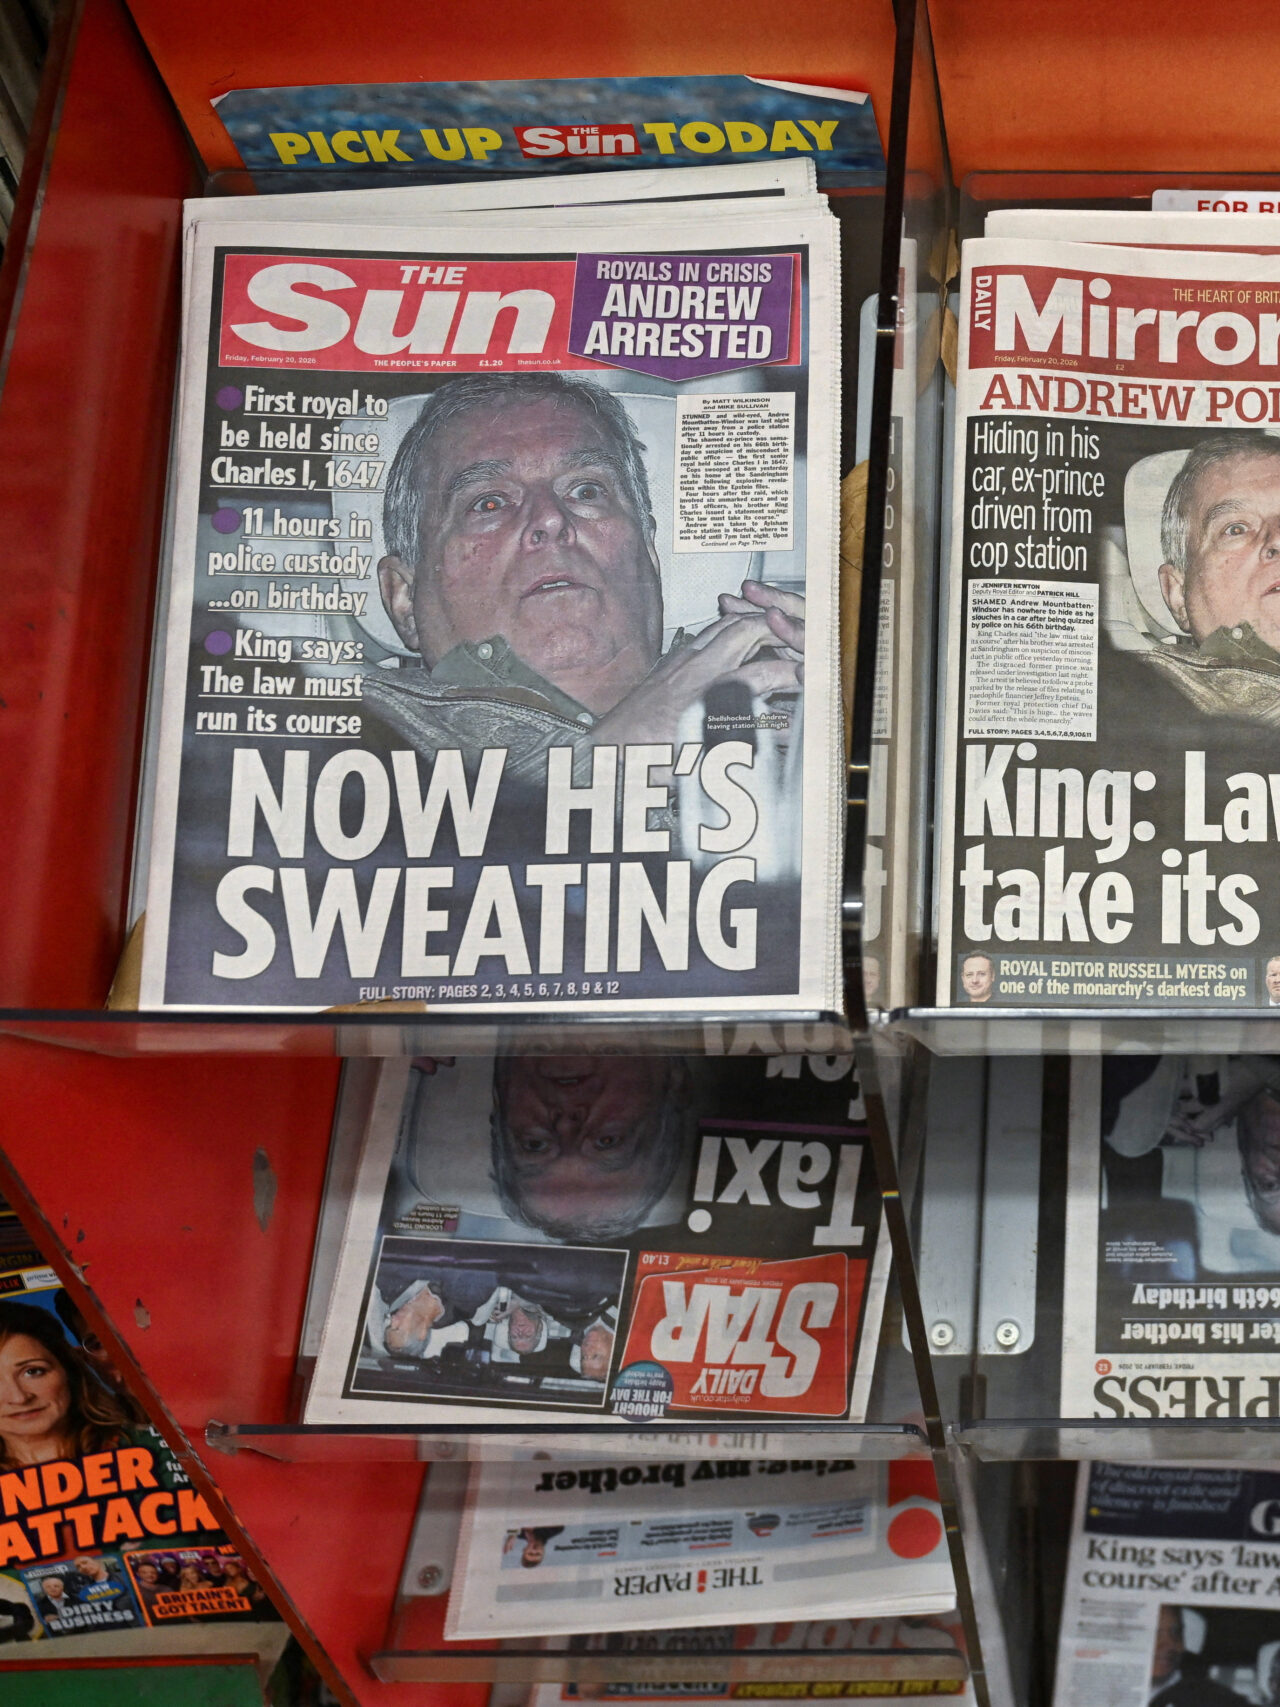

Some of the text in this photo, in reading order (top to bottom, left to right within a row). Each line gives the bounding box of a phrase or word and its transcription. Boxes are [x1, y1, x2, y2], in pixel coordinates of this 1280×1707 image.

[269, 120, 840, 164] PICK UP THE Sun TODAY
[398, 265, 468, 285] THE
[596, 261, 772, 284] ROYALS IN CRISIS
[230, 264, 557, 355] Sun
[600, 284, 762, 321] ANDREW
[974, 274, 992, 331] DAILY
[1173, 288, 1194, 302] THE
[1197, 289, 1236, 303] HEART
[1238, 290, 1253, 303] OF
[584, 321, 772, 359] ARRESTED
[374, 359, 457, 368] THE PEOPLE'S PAPER
[479, 359, 503, 367] £1.20
[243, 386, 388, 421] First royal to
[980, 373, 1194, 422] ANDREW
[221, 422, 379, 453] be held since
[974, 423, 1100, 461] Hiding in his
[210, 457, 385, 491] Charles I, 1647
[972, 464, 1105, 502] car, ex-prince
[971, 499, 1092, 535] driven from
[970, 537, 1087, 576] cop station
[234, 631, 364, 665] King says:
[200, 665, 364, 697] The law must
[196, 705, 362, 735] run its course
[227, 741, 759, 860] NOW HE'S
[963, 743, 1156, 863] King:
[959, 845, 1134, 946] take
[1161, 847, 1260, 946] its
[212, 857, 757, 979] SWEATING
[1000, 961, 1247, 980] ROYAL EDITOR RUSSELL MYERS on
[688, 1136, 865, 1245] Taxi
[642, 1254, 670, 1265] £1.40
[1132, 1283, 1227, 1310] birthday
[651, 1280, 839, 1397] STAR
[1121, 1322, 1205, 1345] brother
[1211, 1322, 1245, 1344] his
[610, 1389, 672, 1402] FOR THE DAY
[690, 1368, 762, 1394] DAILY
[612, 1402, 665, 1417] THOUGHT
[0, 1446, 158, 1517] NDER
[536, 1460, 752, 1494] my brother
[0, 1489, 222, 1567] ATTACK
[1086, 1538, 1156, 1566] King
[1161, 1546, 1224, 1569] says
[614, 1565, 763, 1596] THE i PAPER
[1083, 1569, 1186, 1591] course'
[1191, 1570, 1256, 1596] after
[49, 1608, 135, 1631] BUSINESS
[60, 1600, 113, 1618] DIRTY
[156, 1599, 248, 1617] GOT TALENT
